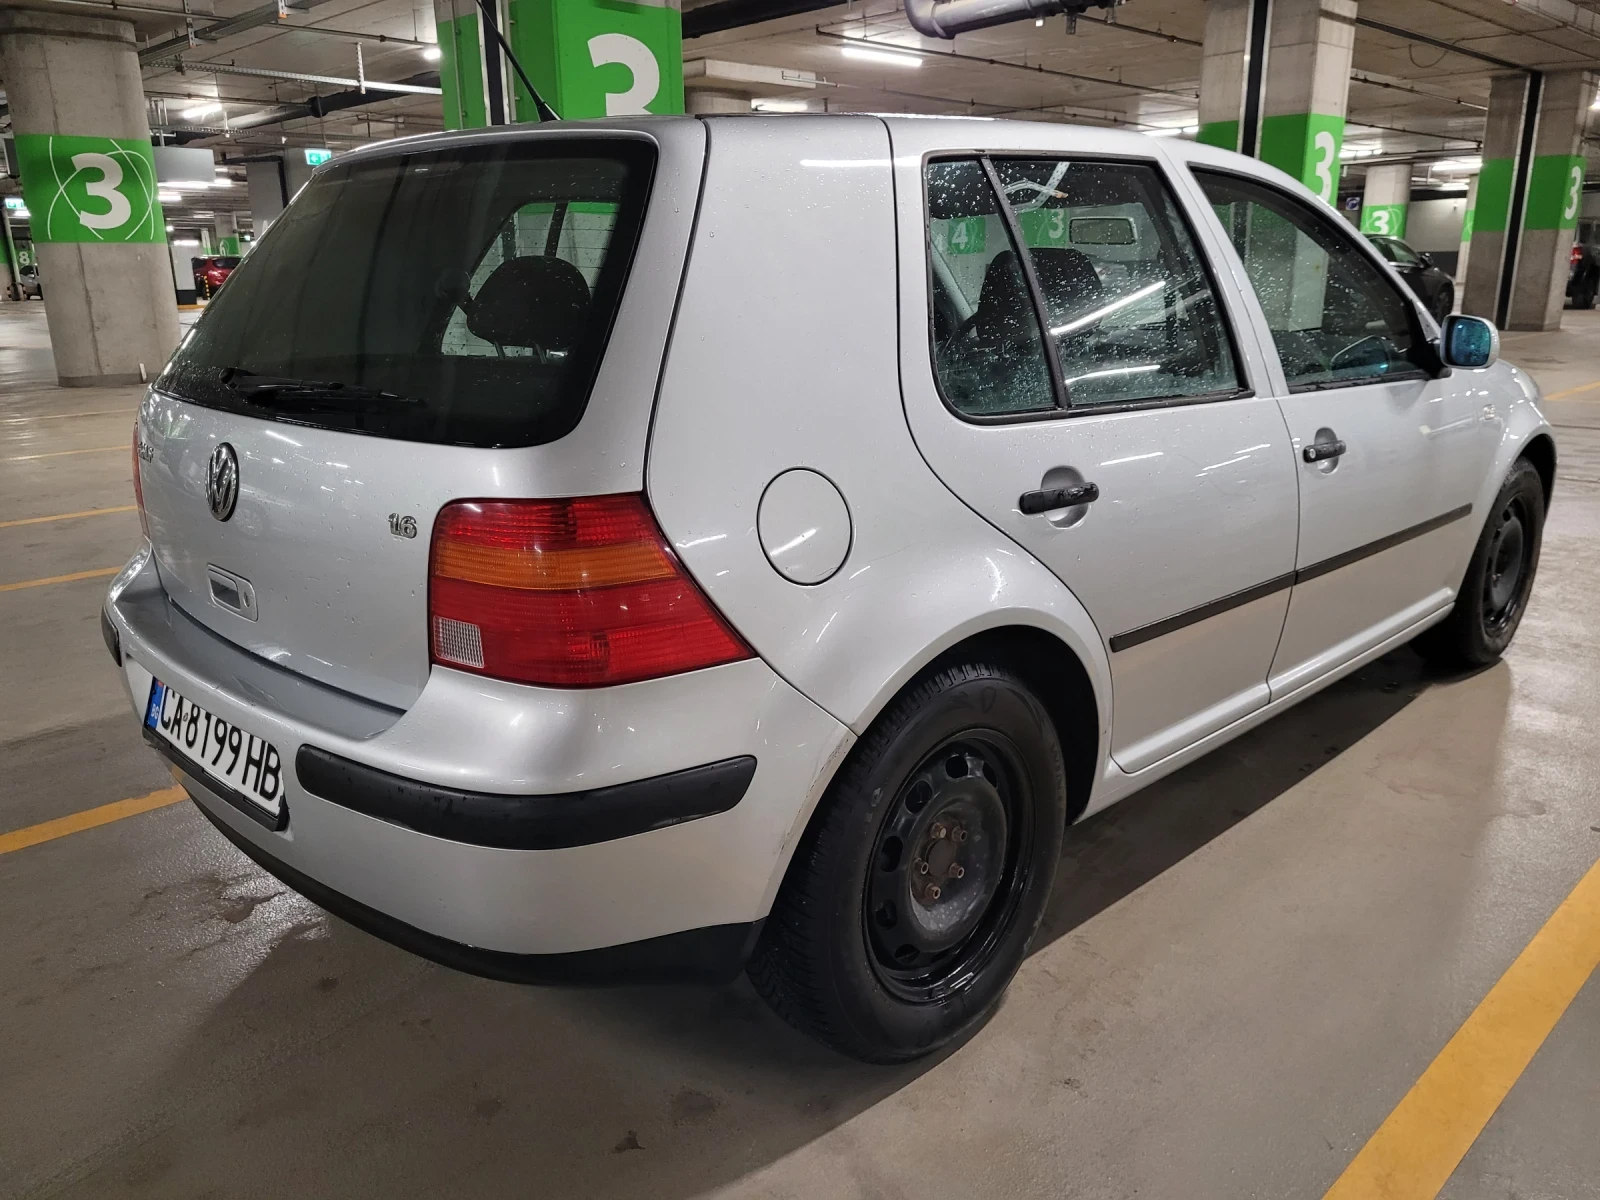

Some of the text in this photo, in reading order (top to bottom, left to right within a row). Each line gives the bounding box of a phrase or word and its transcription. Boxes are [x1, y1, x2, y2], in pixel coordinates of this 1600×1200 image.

[587, 33, 660, 116] 3
[1315, 131, 1336, 202] 3
[71, 152, 132, 230] 3
[1564, 165, 1581, 220] 3
[951, 221, 969, 250] 4
[1048, 208, 1065, 239] 3
[1371, 210, 1390, 234] 3
[19, 251, 30, 265] 8
[151, 703, 160, 720] BG
